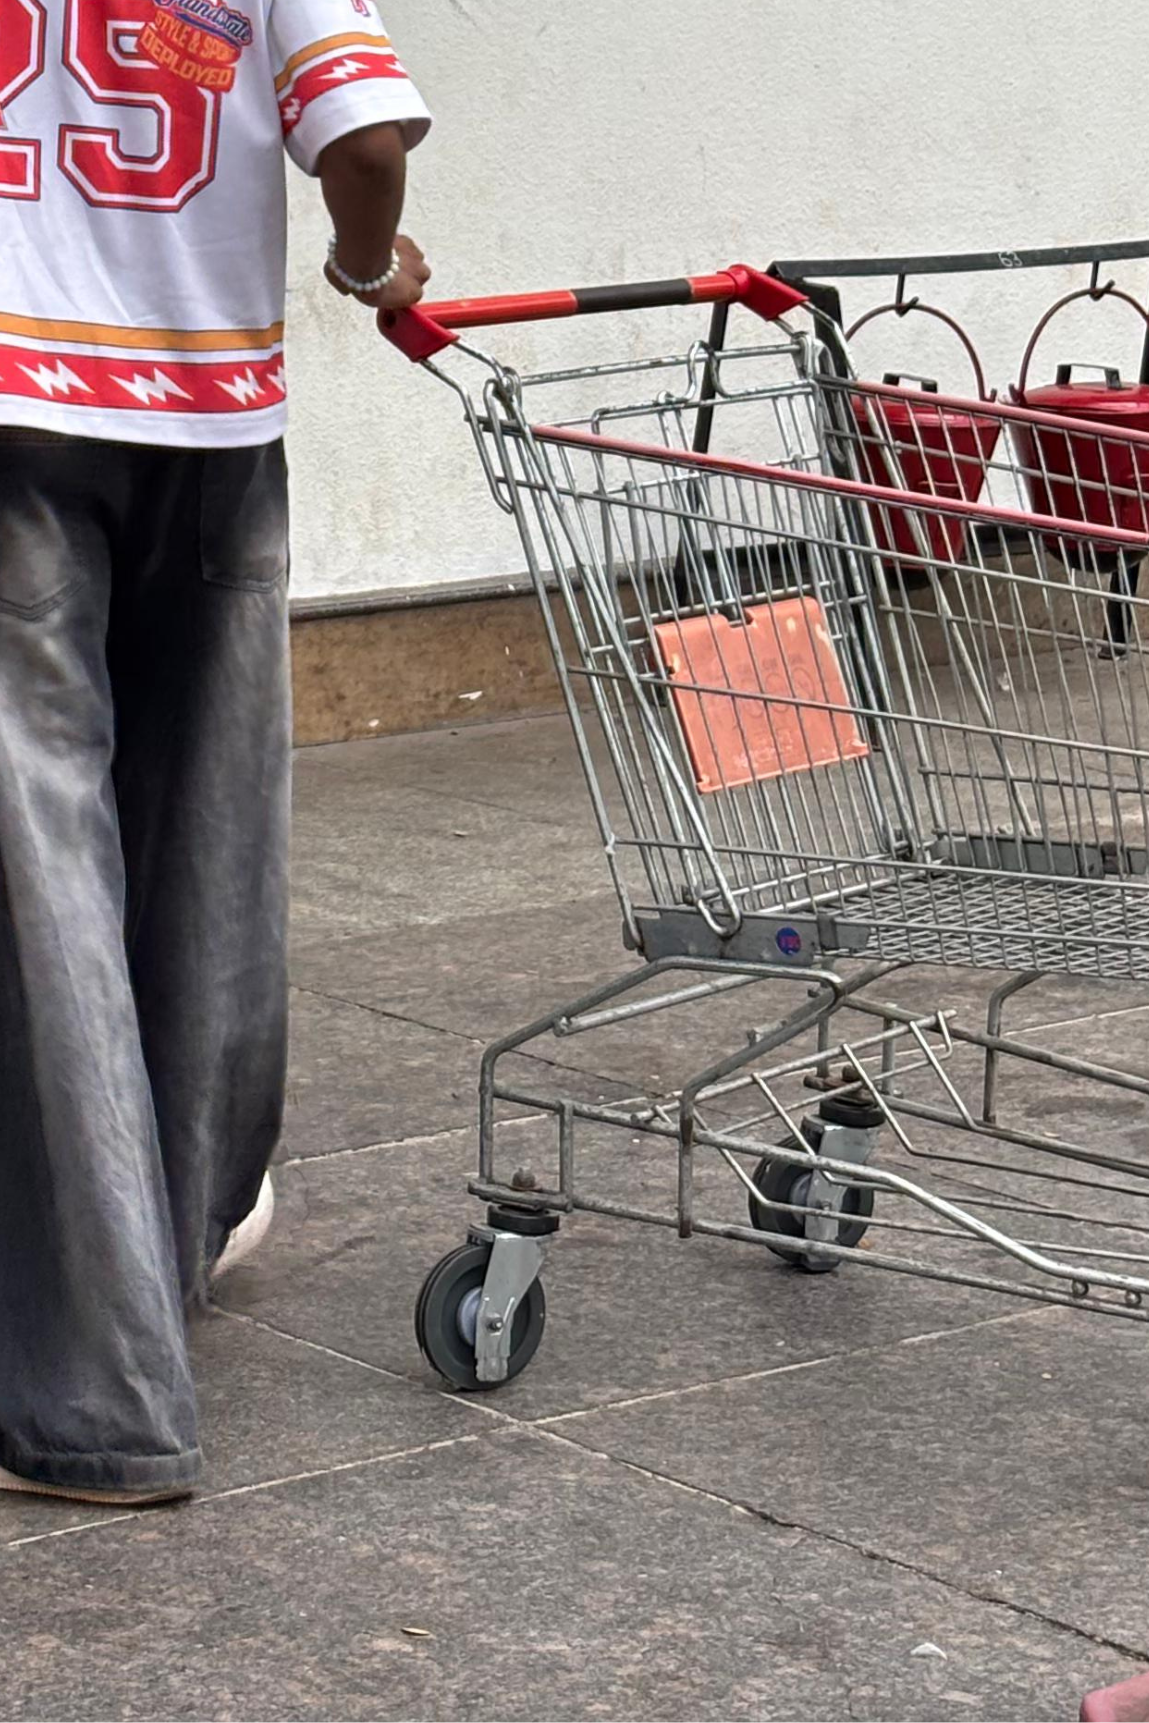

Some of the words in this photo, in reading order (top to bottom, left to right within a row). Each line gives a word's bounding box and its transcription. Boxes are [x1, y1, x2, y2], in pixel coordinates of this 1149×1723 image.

[140, 24, 232, 86] DEPLOYED
[154, 10, 189, 49] STYLE
[187, 31, 201, 54] &
